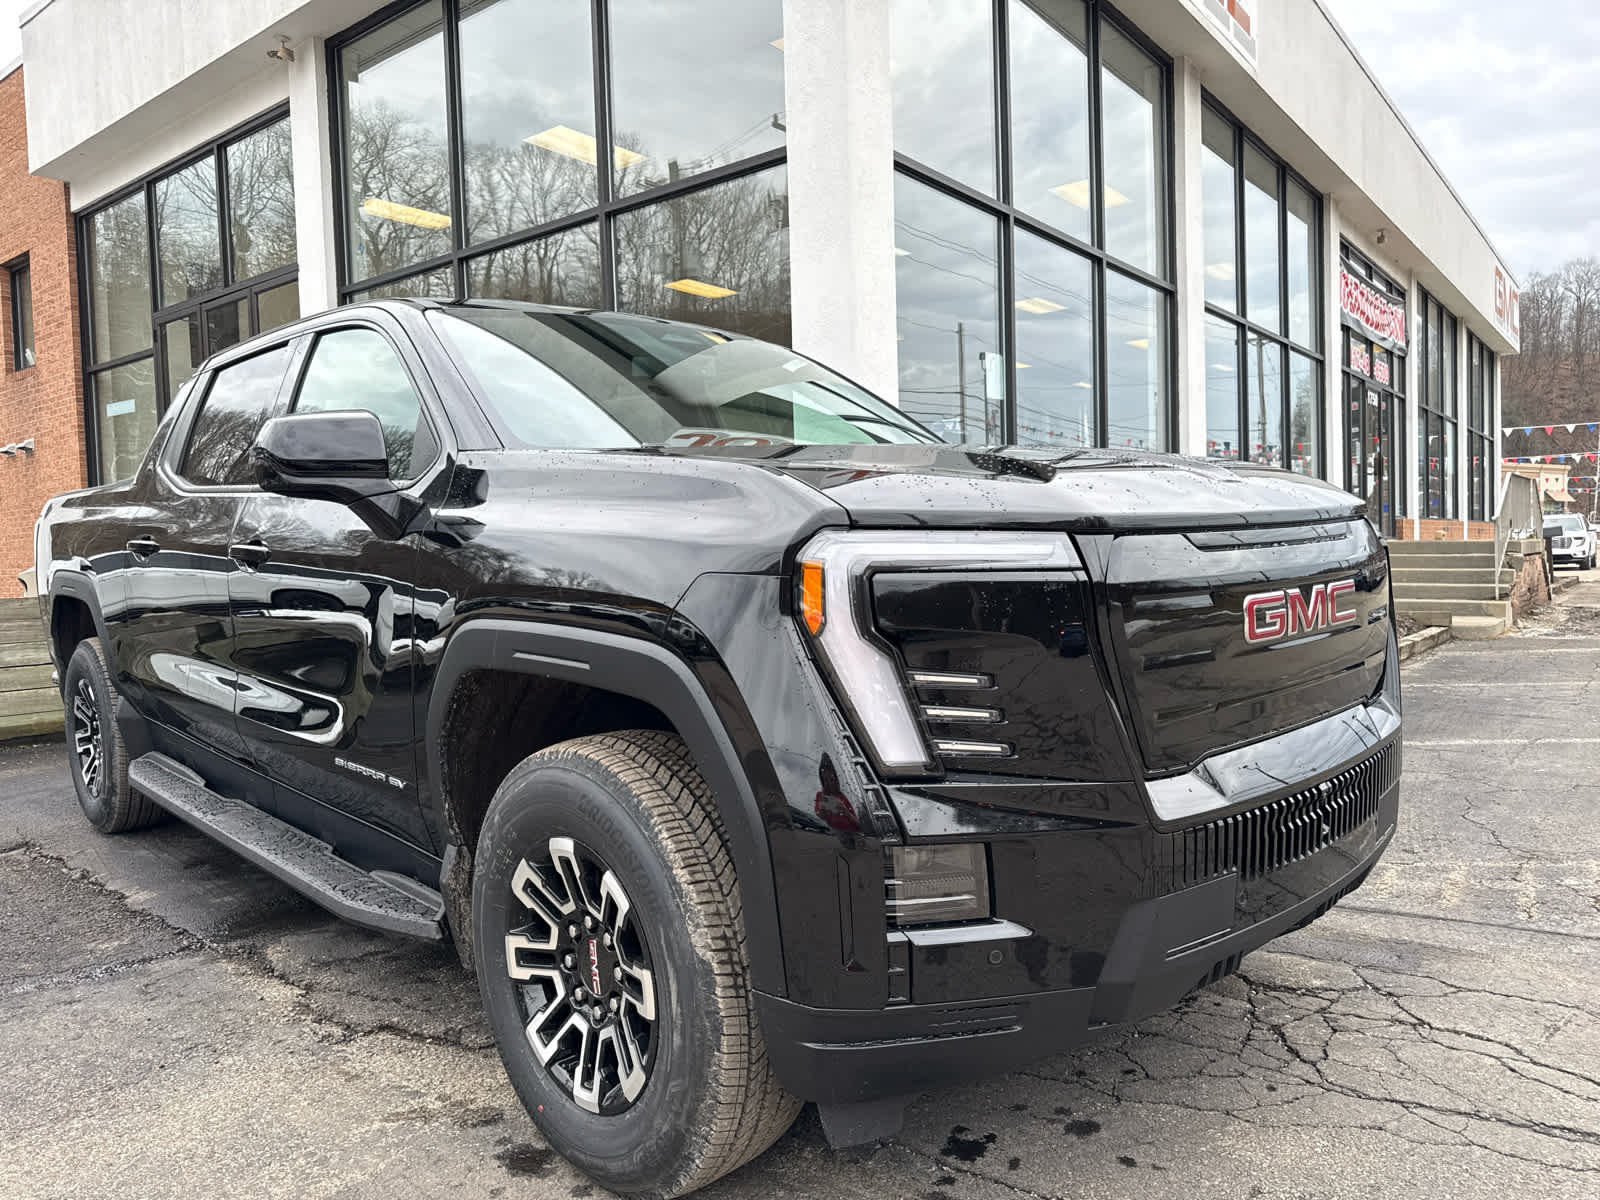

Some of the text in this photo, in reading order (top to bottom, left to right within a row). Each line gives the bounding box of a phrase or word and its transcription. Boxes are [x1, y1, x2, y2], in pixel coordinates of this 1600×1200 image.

[1495, 265, 1519, 336] GMC
[1243, 579, 1357, 644] GMC
[335, 757, 407, 790] SIERRA EV
[588, 939, 601, 994] GMC
